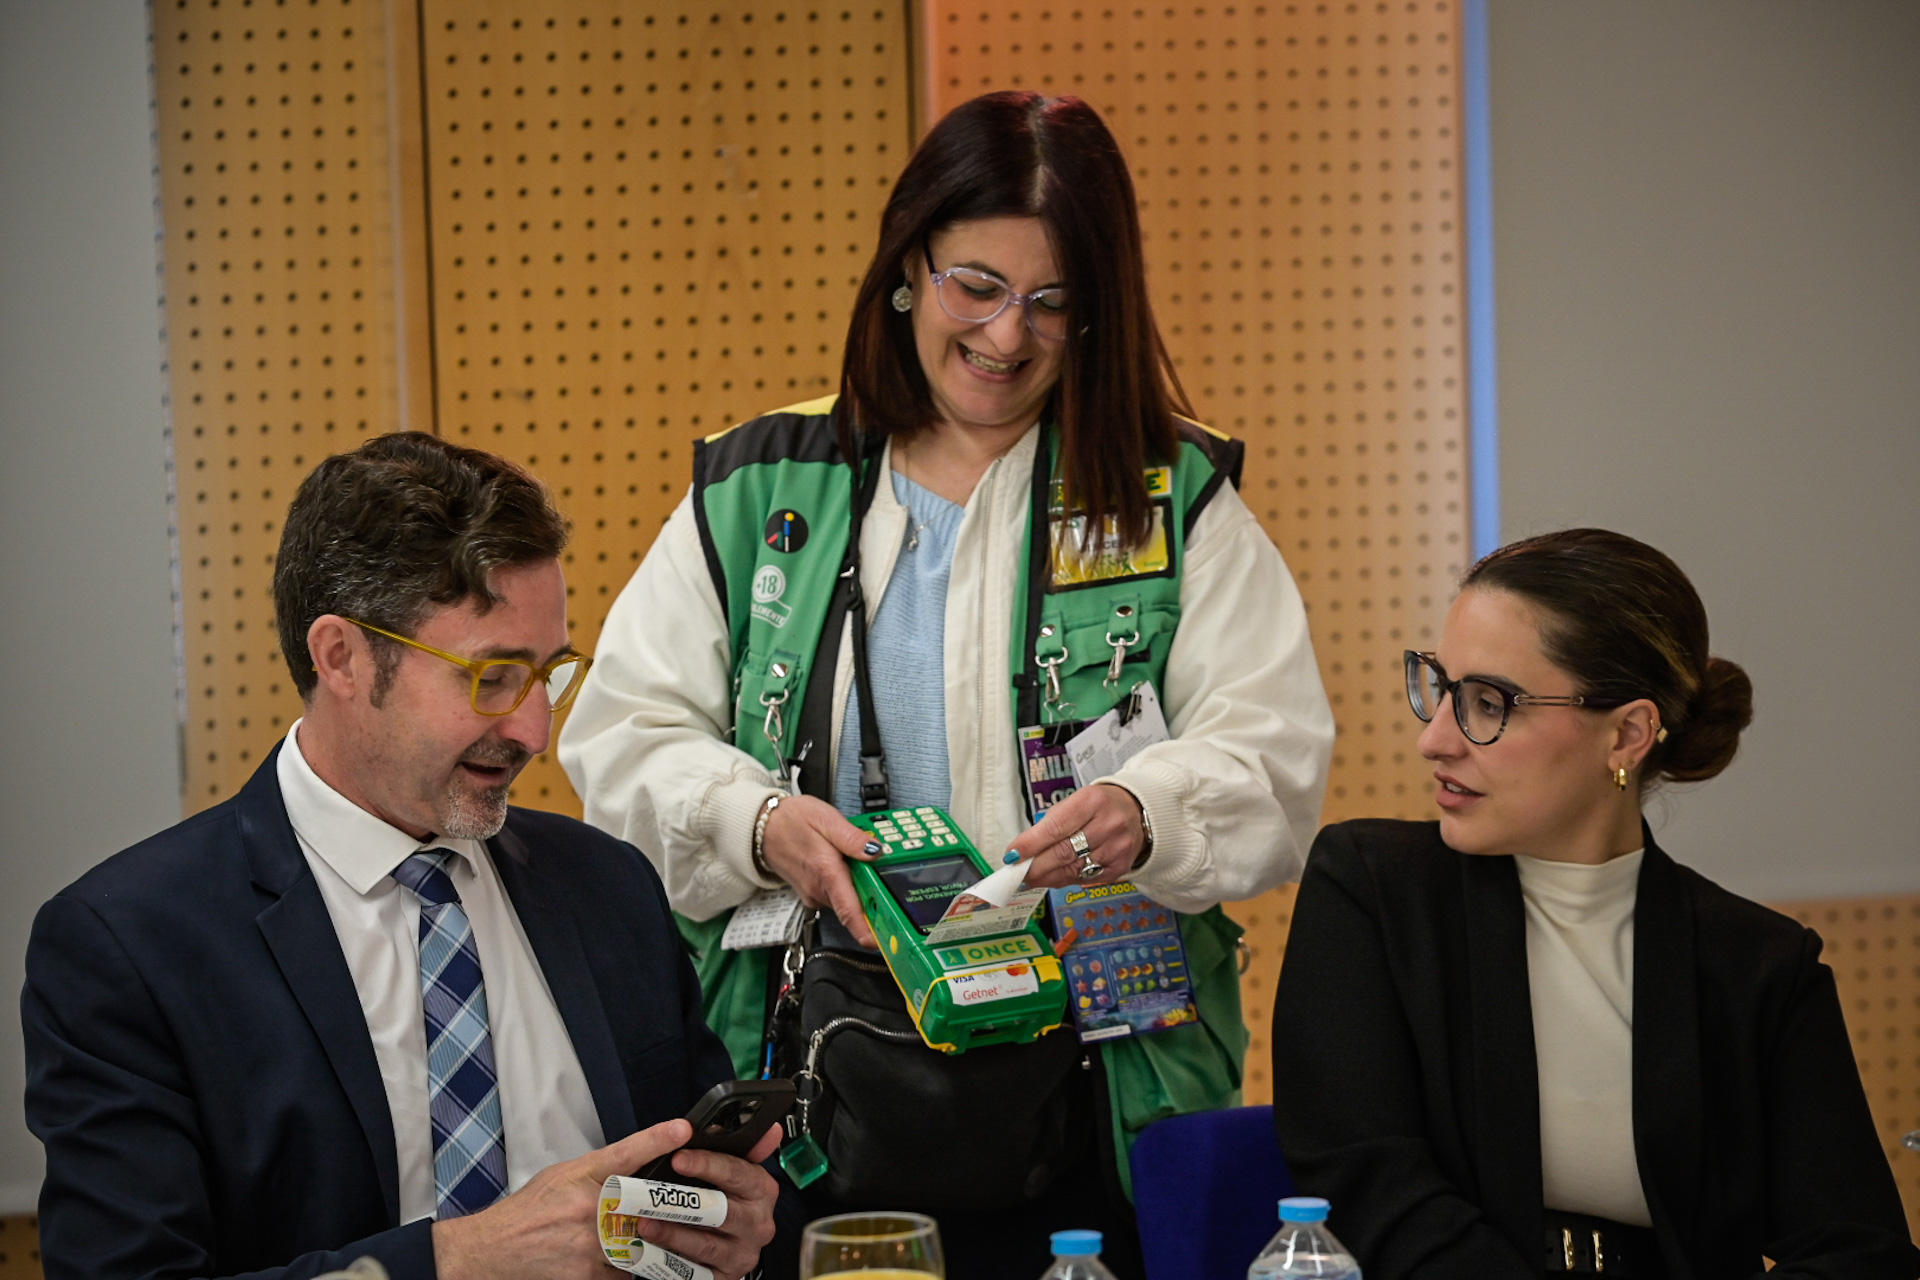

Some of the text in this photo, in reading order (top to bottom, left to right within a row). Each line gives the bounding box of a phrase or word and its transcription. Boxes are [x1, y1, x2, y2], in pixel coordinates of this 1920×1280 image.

[968, 940, 1031, 960] ONCE
[953, 974, 975, 984] VISA
[963, 986, 998, 1001] Getnet
[649, 1187, 701, 1210] DUPLA
